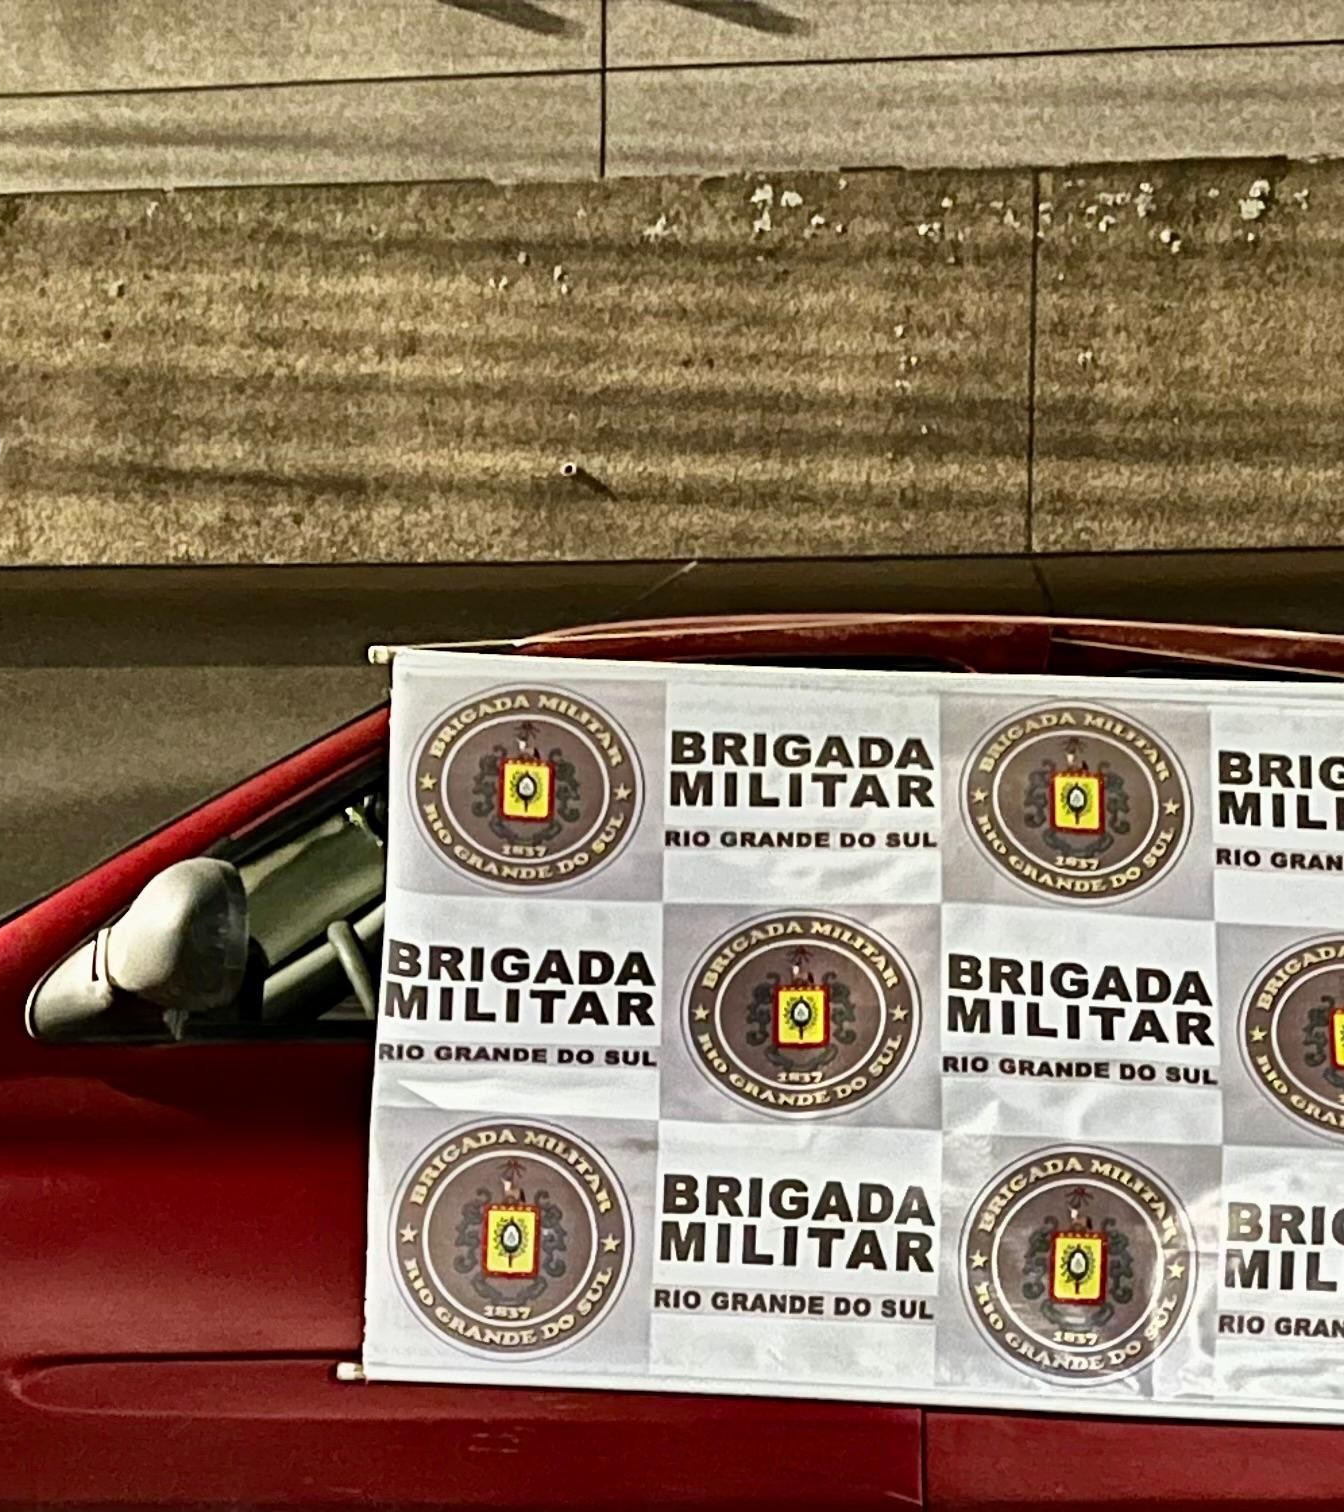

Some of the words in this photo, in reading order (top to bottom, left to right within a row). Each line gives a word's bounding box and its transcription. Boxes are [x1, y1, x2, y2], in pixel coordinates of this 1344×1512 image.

[430, 694, 530, 759] BRIGADA
[539, 695, 623, 767] MILITAR
[671, 730, 934, 769] BRIGADA
[979, 712, 1075, 773] BRIGADA
[1084, 713, 1171, 782] MILITAR
[670, 771, 935, 807] MILITAR
[424, 803, 453, 845] RIO
[453, 846, 553, 879] GRANDE
[559, 852, 589, 874] DO
[592, 813, 624, 854] SUL
[665, 830, 710, 847] RIO
[720, 832, 830, 848] GRANDE
[840, 833, 876, 847] DO
[885, 832, 937, 848] SUL
[977, 816, 1007, 855] RIO
[1009, 855, 1106, 892] GRANDE
[1112, 867, 1140, 888] DO
[1143, 828, 1175, 868] SUL
[1216, 848, 1261, 866] RIO
[388, 939, 655, 986] BRIGADA
[702, 921, 803, 989] BRIGADA
[811, 921, 900, 988] MILITAR
[948, 953, 1212, 1006] BRIGADA
[385, 981, 655, 1025] MILITAR
[948, 996, 1214, 1046] MILITAR
[379, 1044, 424, 1061] RIO
[434, 1046, 547, 1063] GRANDE
[558, 1049, 594, 1064] DO
[605, 1049, 657, 1066] SUL
[698, 1033, 729, 1073] RIO
[729, 1073, 831, 1106] GRANDE
[836, 1078, 867, 1099] DO
[868, 1035, 902, 1077] SUL
[943, 1056, 988, 1072] RIO
[999, 1058, 1109, 1078] GRANDE
[1120, 1064, 1156, 1080] DO
[1166, 1067, 1218, 1085] SUL
[1257, 1055, 1288, 1095] RIO
[410, 1129, 516, 1205] BRIGADA
[524, 1131, 612, 1213] MILITAR
[663, 1174, 935, 1226] BRIGADA
[978, 1157, 1083, 1233] BRIGADA
[1091, 1159, 1178, 1243] MILITAR
[660, 1221, 934, 1272] MILITAR
[404, 1259, 434, 1306] RIO
[435, 1306, 537, 1345] GRANDE
[543, 1316, 575, 1340] DO
[577, 1267, 612, 1316] SUL
[654, 1289, 701, 1309] RIO
[711, 1292, 824, 1315] GRANDE
[834, 1297, 871, 1316] DO
[881, 1300, 934, 1319] SUL
[974, 1282, 1003, 1331] RIO
[1005, 1332, 1104, 1371] GRANDE
[1111, 1341, 1141, 1365] DO
[1144, 1295, 1177, 1342] SUL
[1219, 1315, 1265, 1335] RIO
